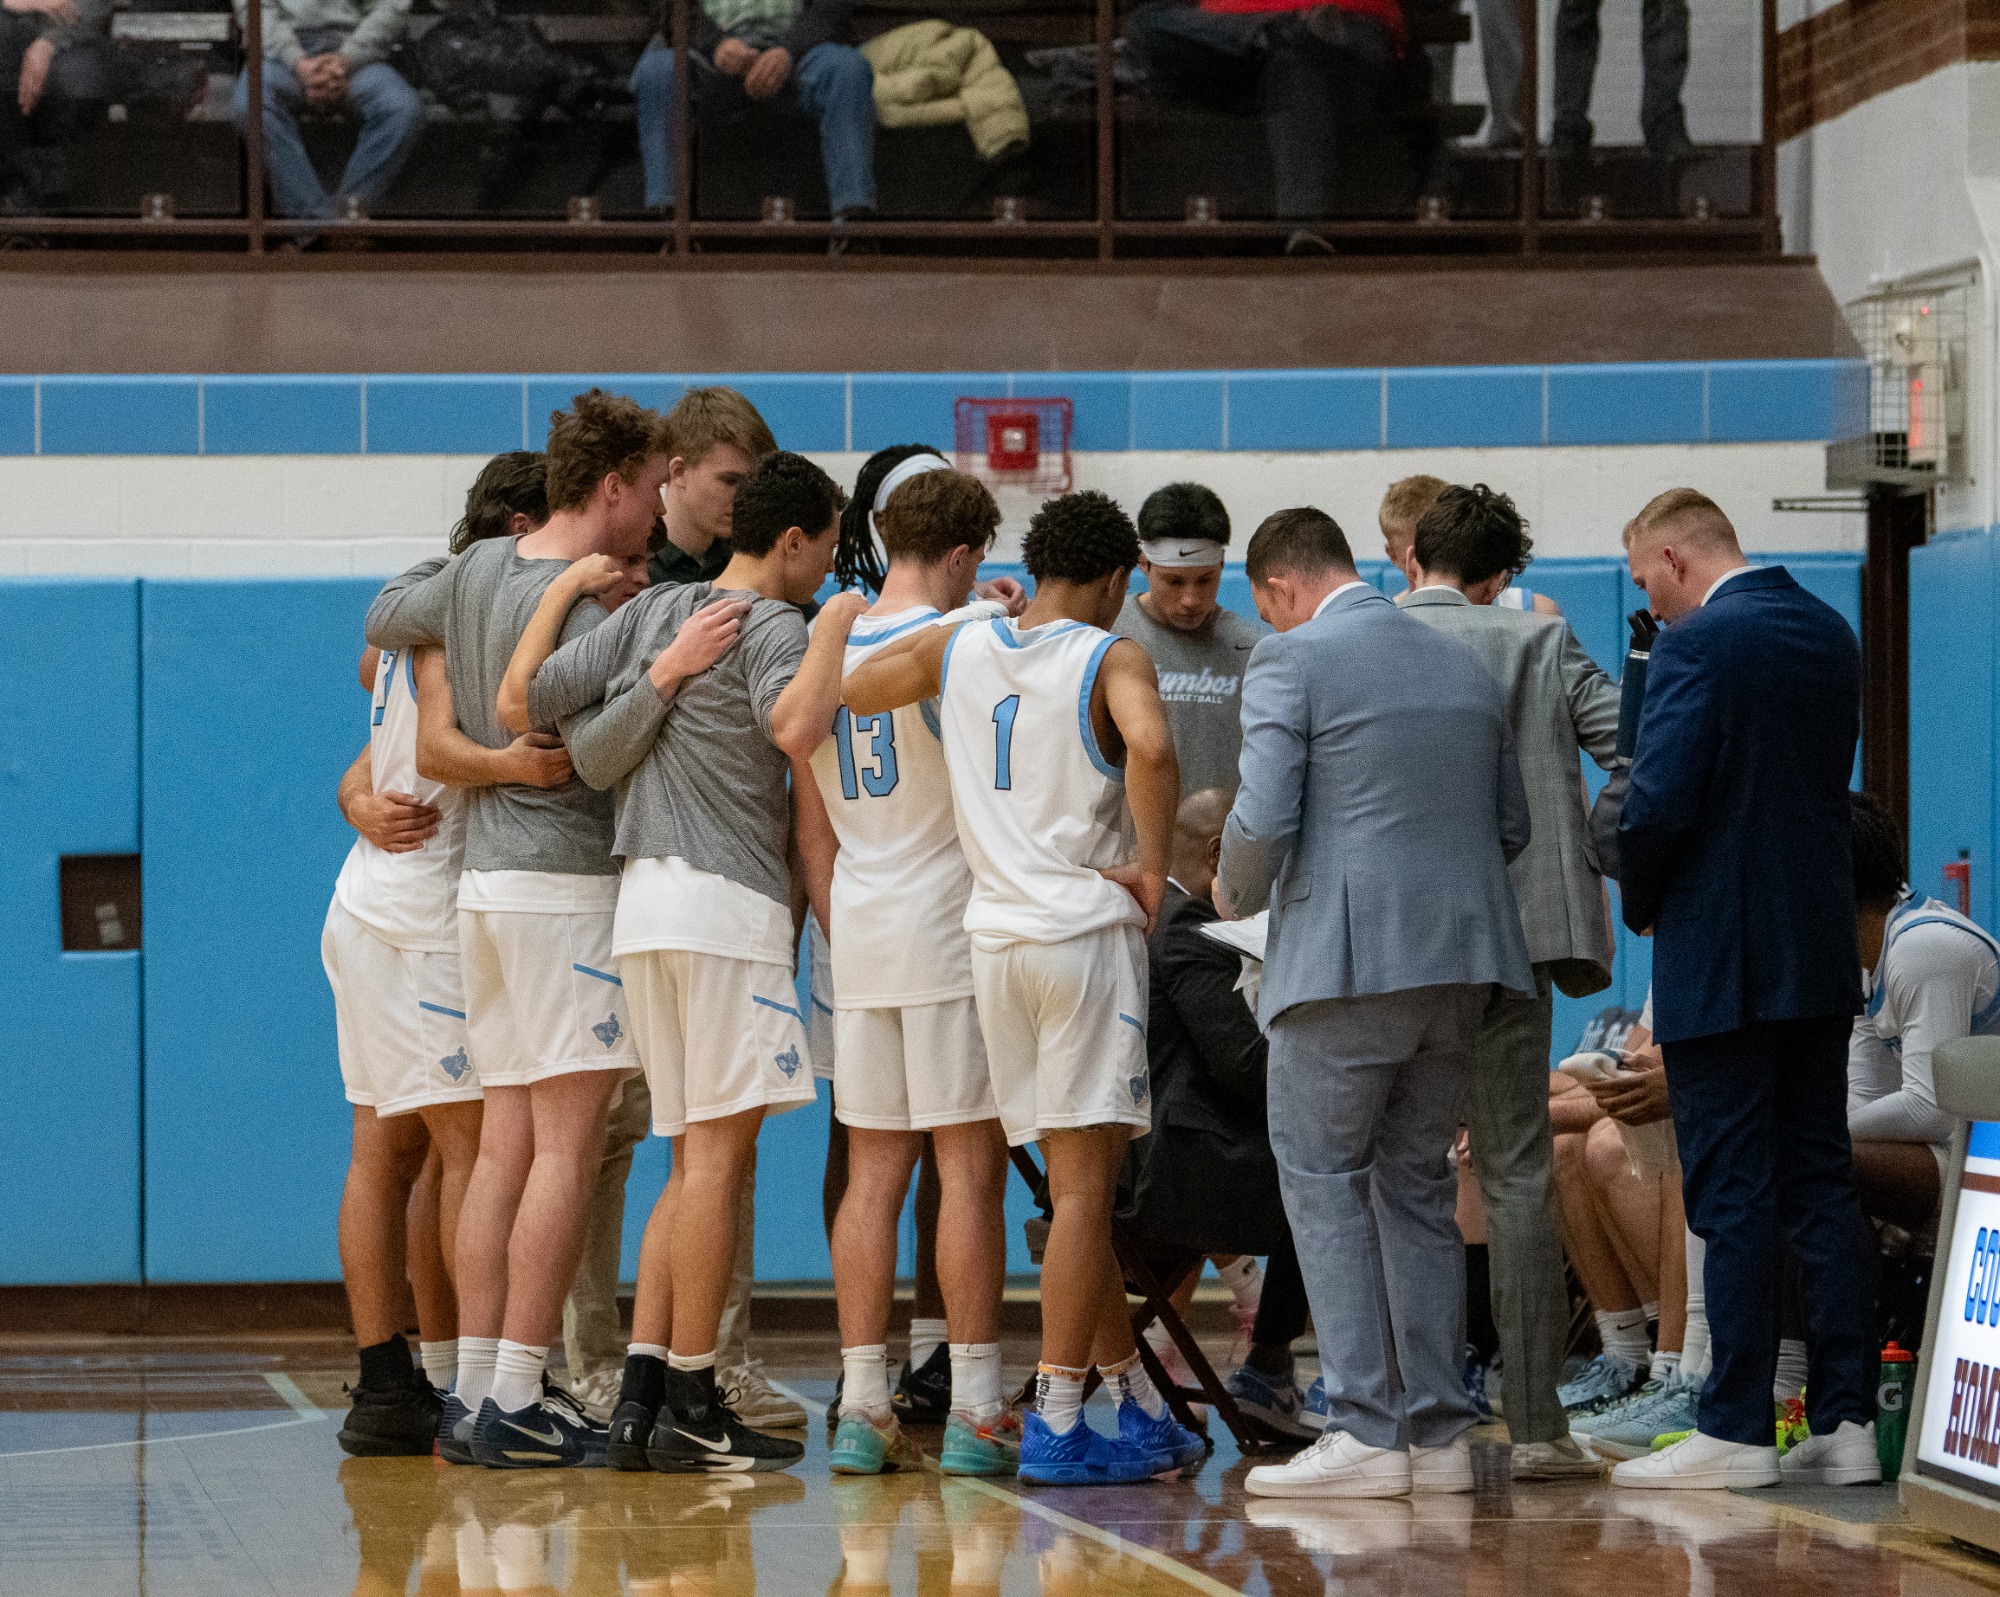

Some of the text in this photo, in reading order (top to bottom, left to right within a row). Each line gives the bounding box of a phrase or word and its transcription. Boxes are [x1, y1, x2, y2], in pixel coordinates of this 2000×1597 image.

[1156, 664, 1239, 696] umbos
[831, 704, 899, 799] 13
[992, 694, 1020, 790] 1
[1877, 1381, 1903, 1412] G
